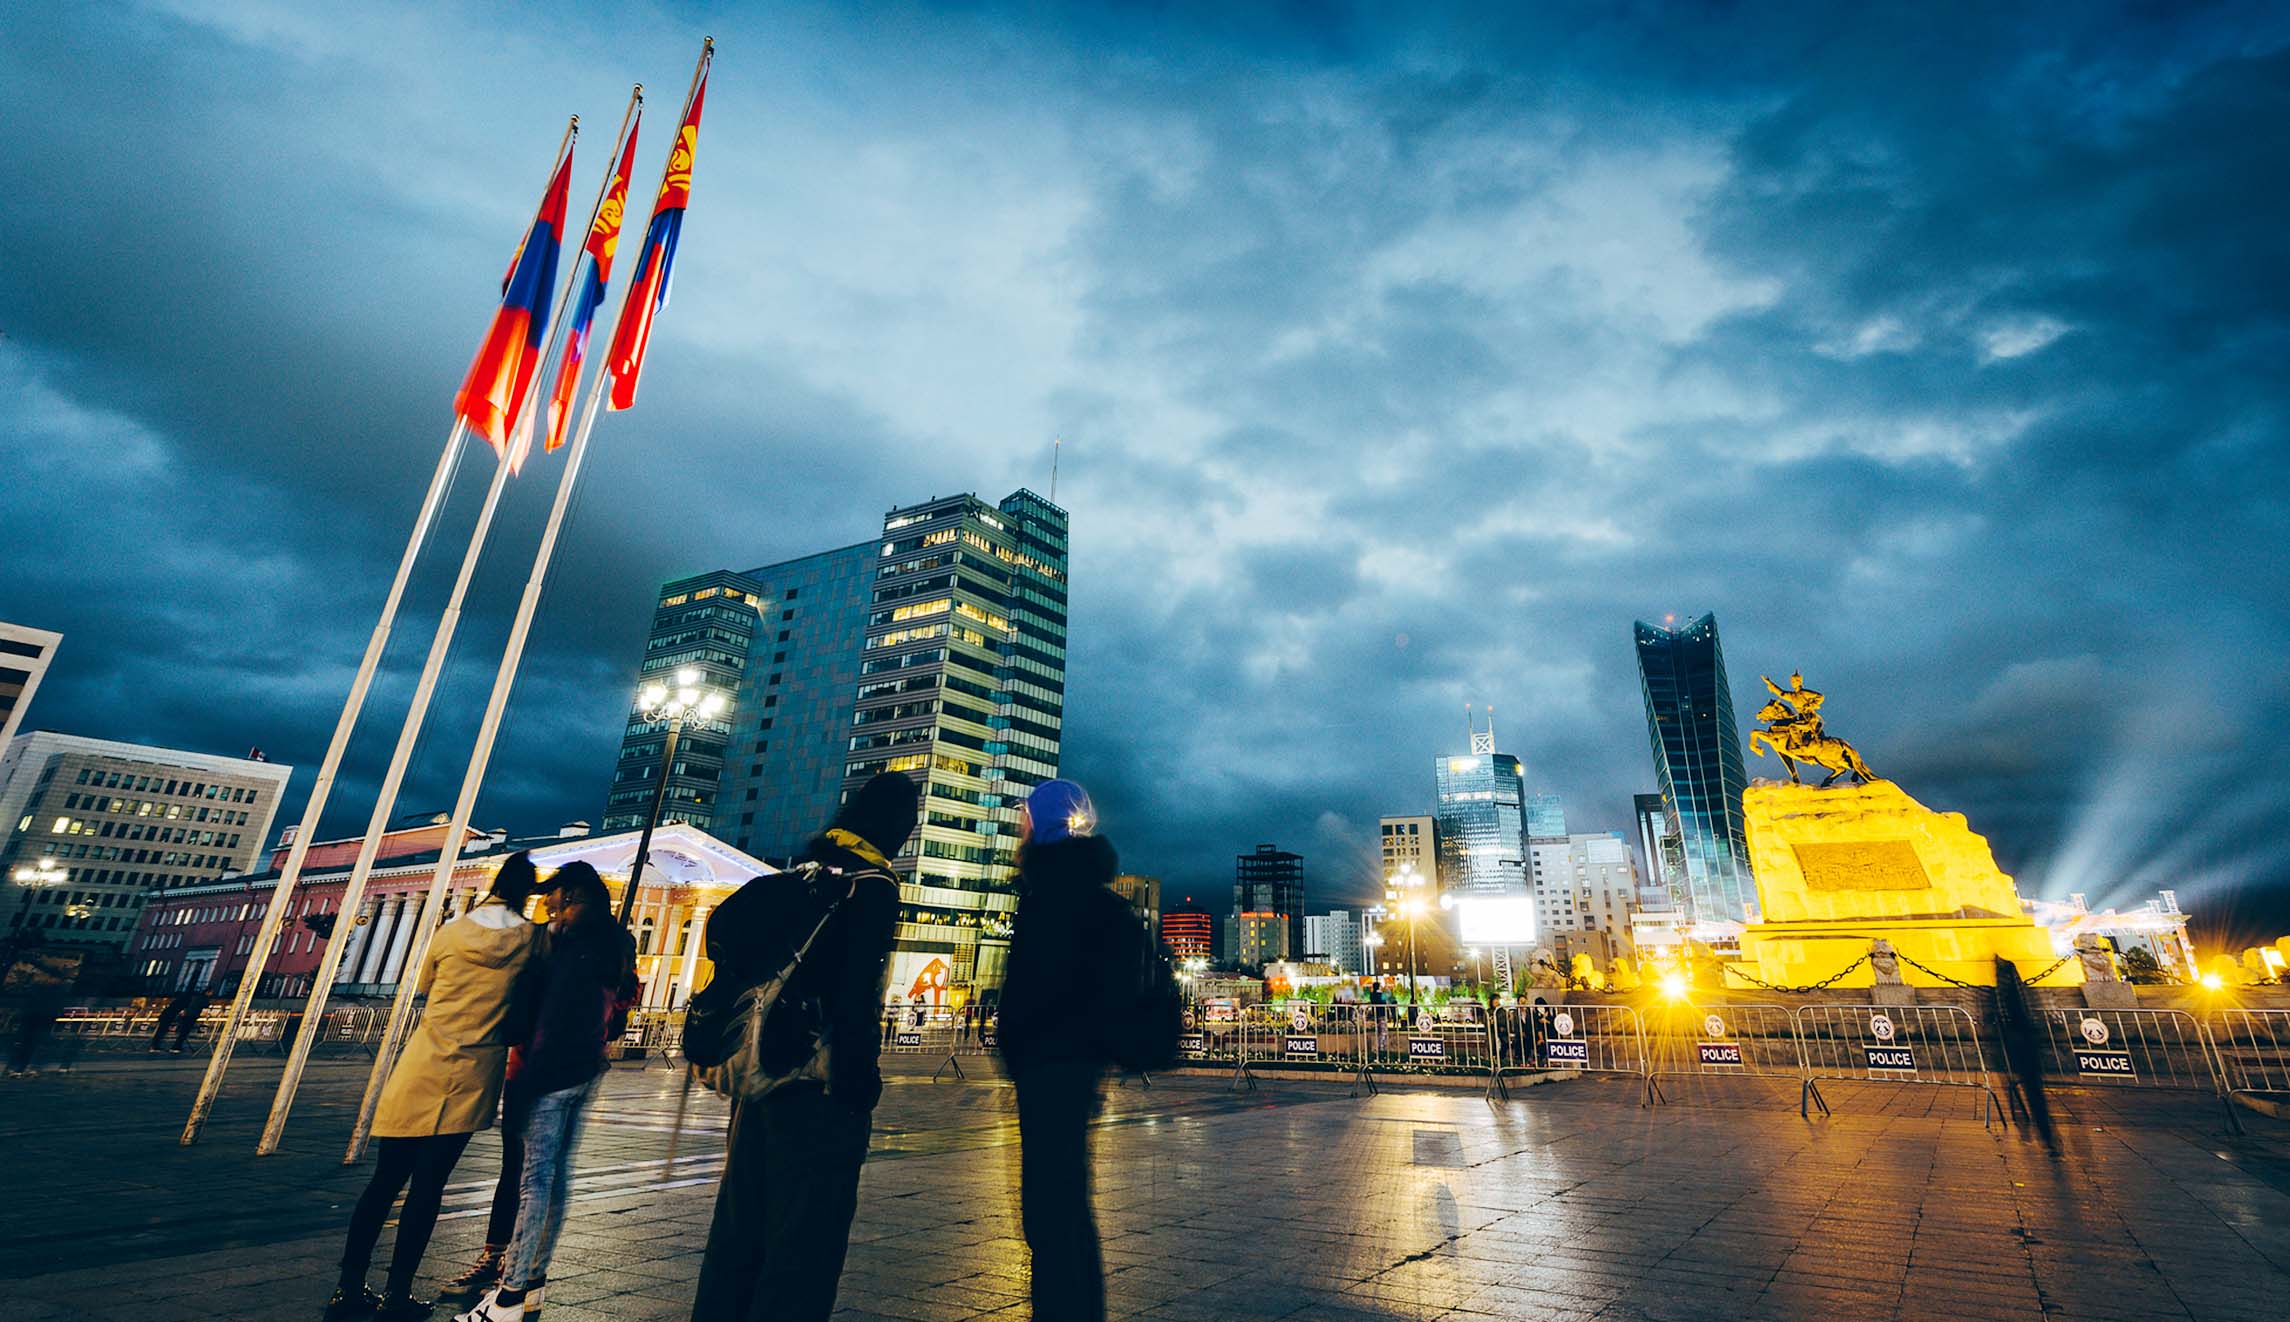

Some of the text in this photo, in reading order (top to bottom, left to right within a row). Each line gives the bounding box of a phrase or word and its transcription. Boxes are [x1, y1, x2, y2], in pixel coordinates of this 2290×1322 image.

[898, 1035, 920, 1044] POLICE
[1287, 1041, 1316, 1051] POLICE
[1411, 1042, 1442, 1053] POLICE
[1550, 1045, 1586, 1057] POLICE
[1701, 1049, 1739, 1061] POLICE
[1869, 1052, 1912, 1065] POLICE
[2079, 1056, 2130, 1070] POLICE
